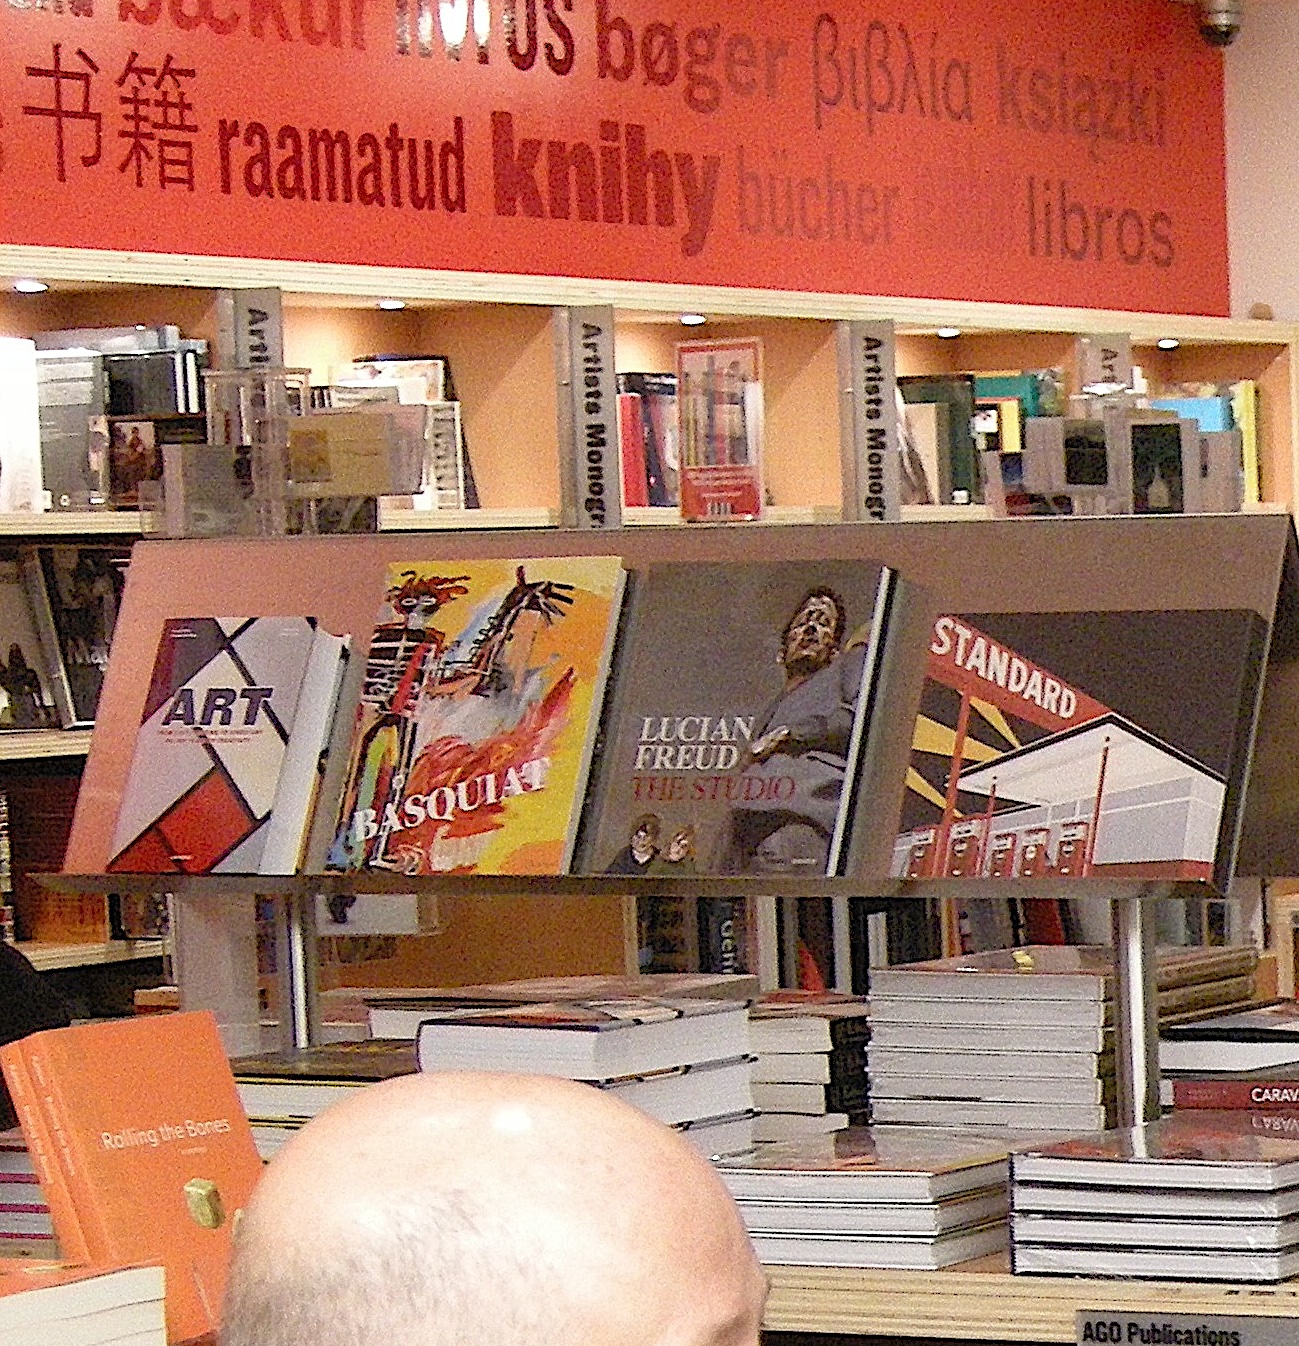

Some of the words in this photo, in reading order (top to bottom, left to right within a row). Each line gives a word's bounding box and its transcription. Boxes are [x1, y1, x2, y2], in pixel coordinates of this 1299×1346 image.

[22, 42, 198, 191] 书籍
[218, 115, 468, 214] raamatud
[490, 110, 720, 257] knihy
[734, 145, 900, 246] bücher
[1027, 175, 1175, 268] libros
[579, 322, 606, 416] Artists
[863, 336, 886, 421] Artists
[583, 423, 609, 529] Monogr
[161, 686, 275, 728] ART
[932, 615, 1078, 720] STANDARD
[633, 744, 740, 770] FREUD
[638, 716, 756, 743] LUCIAN
[353, 755, 551, 843] BASQUIAT
[631, 775, 686, 801] THE
[692, 775, 796, 801] STUDIO
[101, 1128, 159, 1150] Rolling
[160, 1121, 185, 1140] the
[184, 1118, 231, 1139] Bones
[1082, 1320, 1122, 1343] AGO
